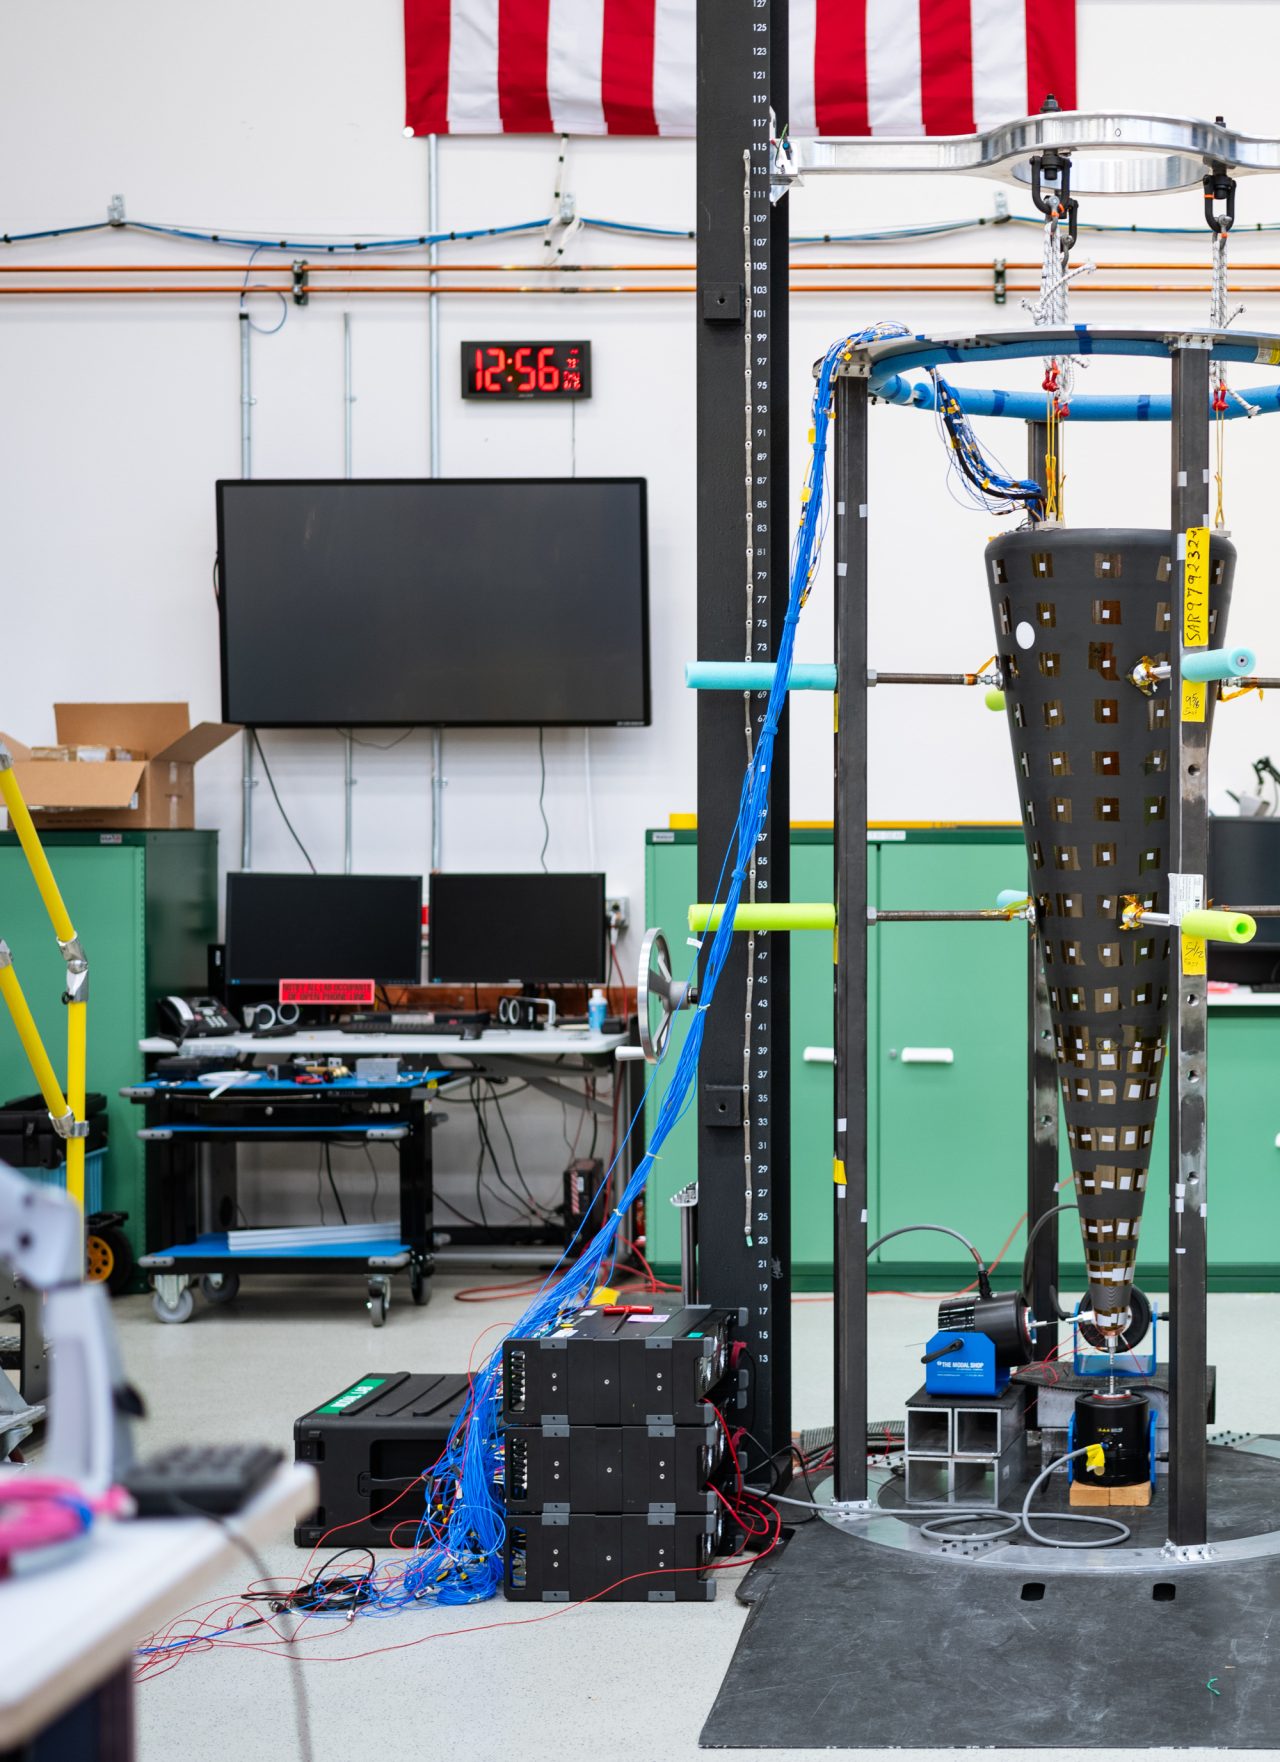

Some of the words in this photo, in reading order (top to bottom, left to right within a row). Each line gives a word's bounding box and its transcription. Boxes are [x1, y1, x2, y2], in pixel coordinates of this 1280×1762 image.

[753, 0, 767, 8] 127
[752, 23, 768, 32] 125
[752, 47, 767, 56] 123
[752, 70, 766, 80] 121
[752, 94, 768, 104] 119
[752, 118, 767, 128] 117
[752, 142, 768, 152] 115
[752, 166, 768, 175] 113
[753, 190, 766, 199] 111
[753, 214, 768, 223] 109
[753, 238, 768, 247] 107
[753, 261, 768, 271] 105
[753, 285, 768, 295] 103
[753, 309, 766, 319] 101
[756, 333, 768, 342] 99
[756, 357, 768, 366] 97
[475, 347, 560, 392] 12:56
[756, 381, 768, 390] 95
[756, 404, 768, 414] 93
[756, 428, 766, 437] 91
[756, 452, 768, 461] 89
[756, 476, 768, 485] 87
[756, 500, 768, 509] 85
[756, 523, 768, 533] 83
[757, 571, 768, 580] 79
[757, 595, 768, 604] 77
[757, 619, 768, 628] 75
[756, 642, 768, 652] 73
[756, 690, 768, 700] 69
[757, 832, 768, 842] 57
[757, 856, 768, 866] 55
[757, 880, 768, 889] 53
[757, 951, 768, 960] 47
[757, 975, 768, 984] 45
[757, 999, 769, 1008] 43
[757, 1023, 767, 1031] 41
[757, 1046, 768, 1055] 39
[757, 1070, 768, 1079] 37
[757, 1093, 769, 1103] 35
[757, 1117, 769, 1127] 33
[757, 1141, 767, 1150] 31
[757, 1164, 769, 1174] 29
[757, 1188, 769, 1198] 27
[757, 1212, 769, 1221] 25
[757, 1236, 769, 1245] 23
[757, 1259, 767, 1269] 21
[759, 1283, 769, 1292] 19
[758, 1306, 769, 1316] 17
[758, 1330, 769, 1340] 15
[758, 1354, 769, 1363] 13
[952, 1361, 970, 1369] MODAL
[970, 1361, 985, 1369] SHOP
